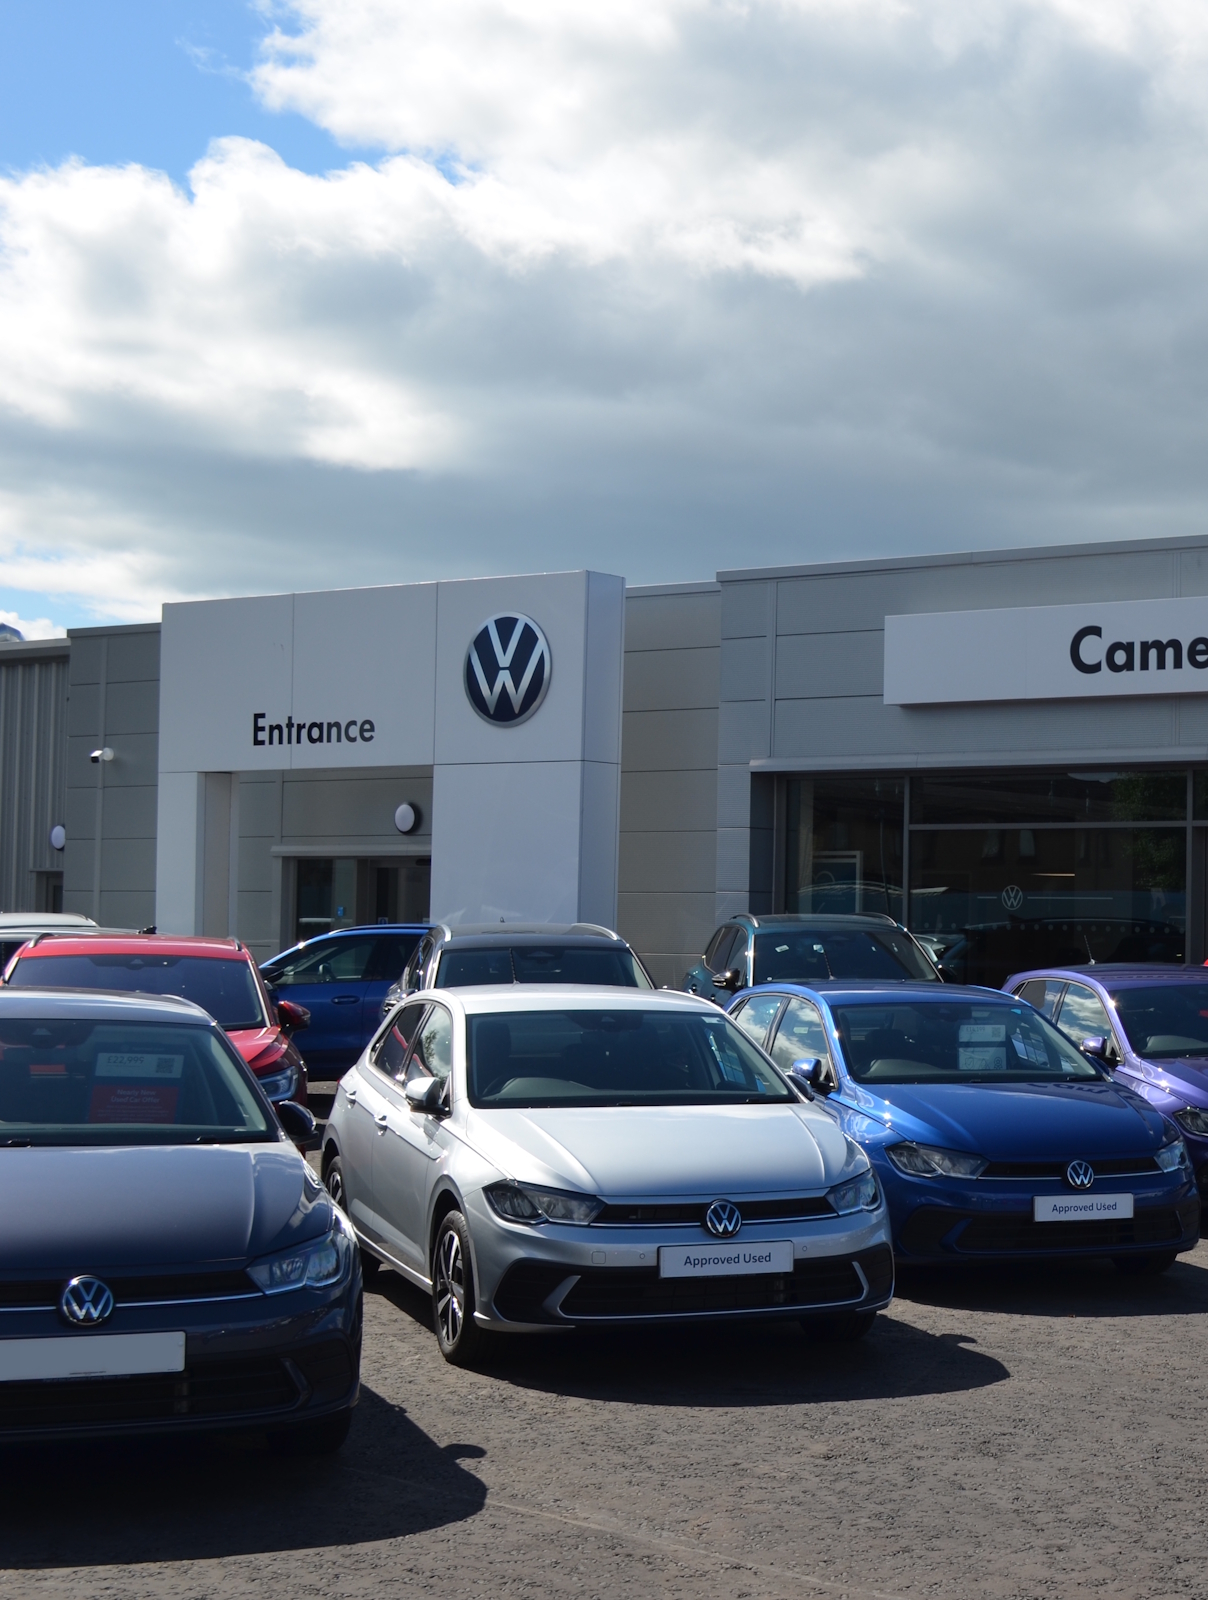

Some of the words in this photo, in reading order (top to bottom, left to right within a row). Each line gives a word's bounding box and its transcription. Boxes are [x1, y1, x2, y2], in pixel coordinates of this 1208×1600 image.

[253, 713, 375, 746] Entrance
[107, 1055, 145, 1065] £22,999
[110, 1095, 129, 1103] Used
[117, 1090, 139, 1098] Nearly
[1051, 1202, 1094, 1214] Approved
[1096, 1201, 1117, 1211] Used
[683, 1253, 740, 1269] Approved
[743, 1252, 772, 1264] Used
